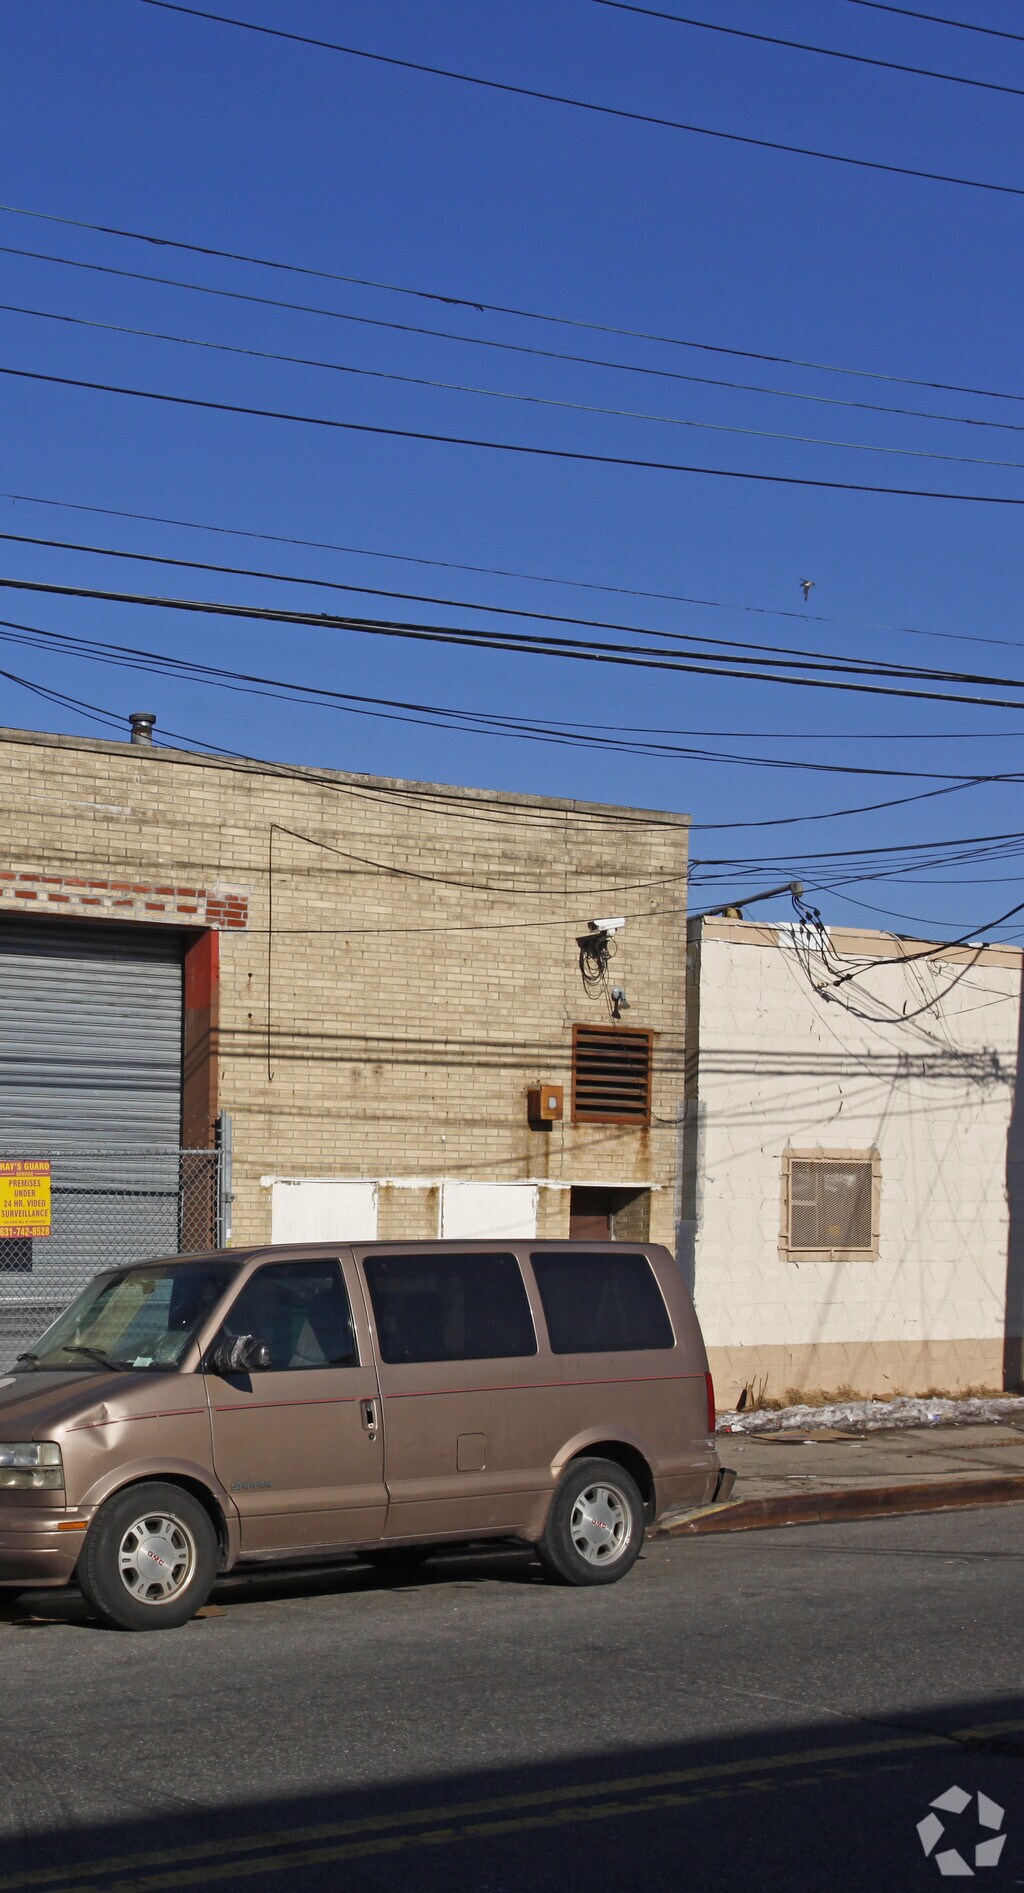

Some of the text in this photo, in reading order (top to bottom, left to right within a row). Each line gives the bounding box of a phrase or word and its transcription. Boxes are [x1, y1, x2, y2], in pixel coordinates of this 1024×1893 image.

[0, 1162, 50, 1171] RAY'S GUARD
[8, 1179, 41, 1188] PREMISES
[14, 1189, 36, 1198] UNDER
[3, 1199, 46, 1208] 24 HR. VIDEO
[1, 1209, 49, 1218] SURVEILLANCE
[0, 1226, 50, 1237] 631-742-8528
[147, 1550, 165, 1567] GMC
